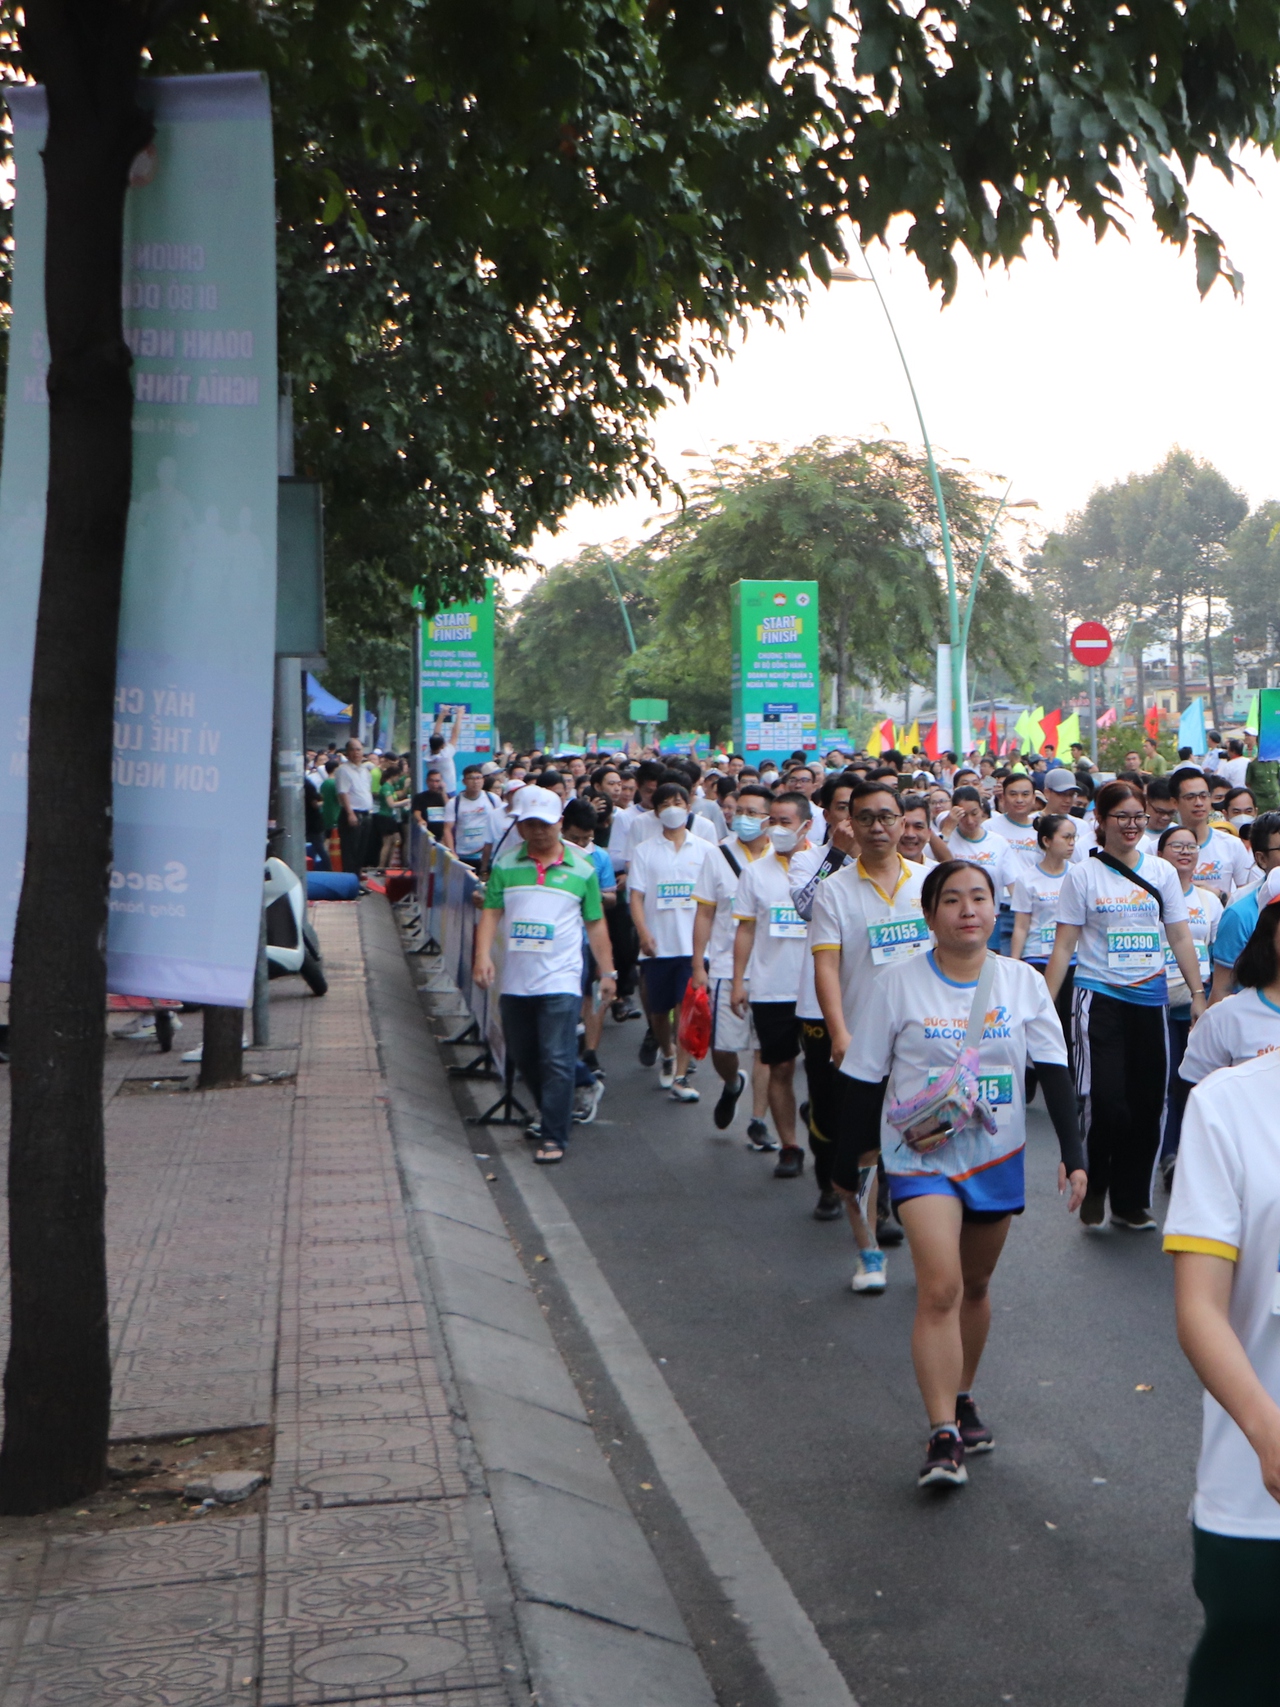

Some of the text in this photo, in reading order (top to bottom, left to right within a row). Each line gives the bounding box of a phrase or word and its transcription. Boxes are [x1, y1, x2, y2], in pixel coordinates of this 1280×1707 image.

[434, 612, 472, 628] START
[763, 615, 797, 631] START
[433, 627, 473, 642] FINISH
[762, 630, 798, 645] FINISH
[663, 884, 692, 897] 21148
[1095, 902, 1157, 914] SACOMBANK
[516, 924, 547, 937] 21429
[880, 922, 918, 943] 21155
[1115, 935, 1154, 950] 20390
